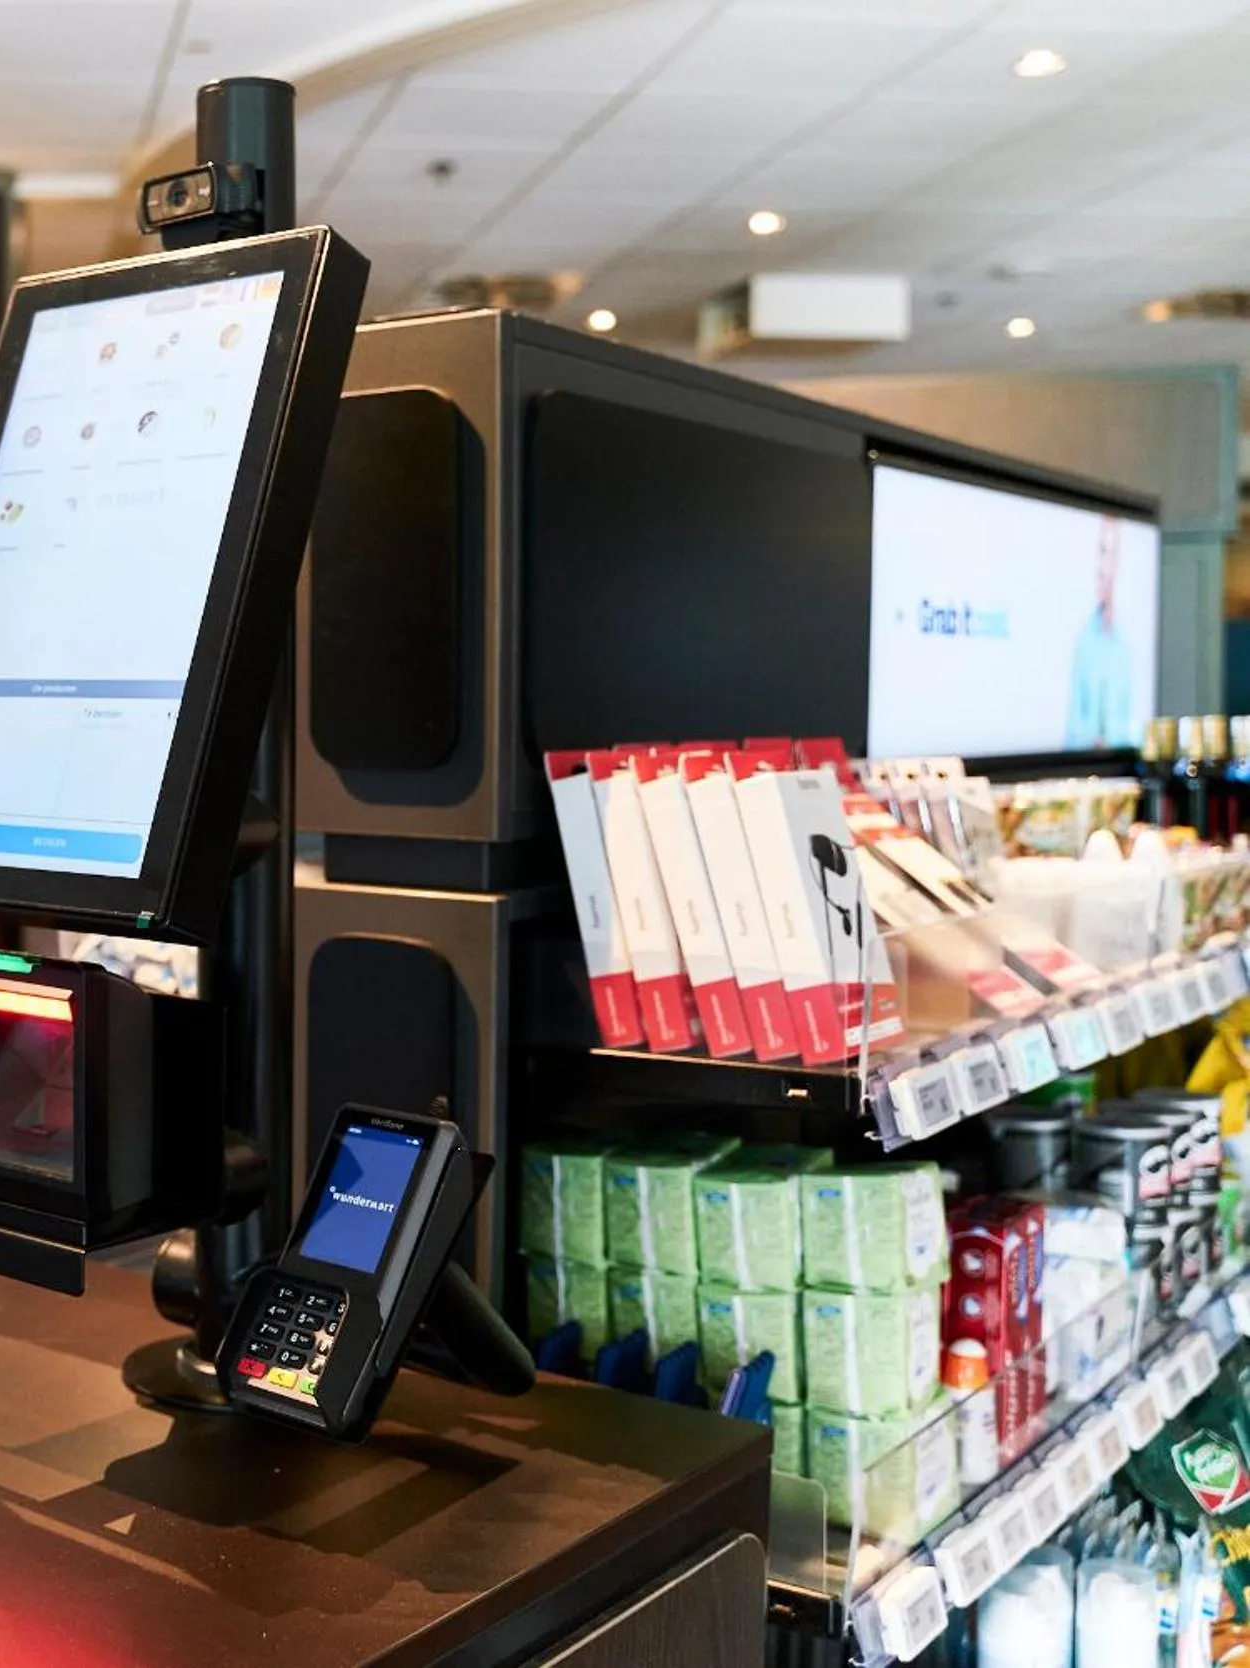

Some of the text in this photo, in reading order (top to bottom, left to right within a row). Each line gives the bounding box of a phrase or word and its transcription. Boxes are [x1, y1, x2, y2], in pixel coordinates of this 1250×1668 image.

[305, 1295, 316, 1306] 2
[297, 1313, 308, 1324] 5
[328, 1322, 338, 1333] 6
[280, 1351, 290, 1362] 0
